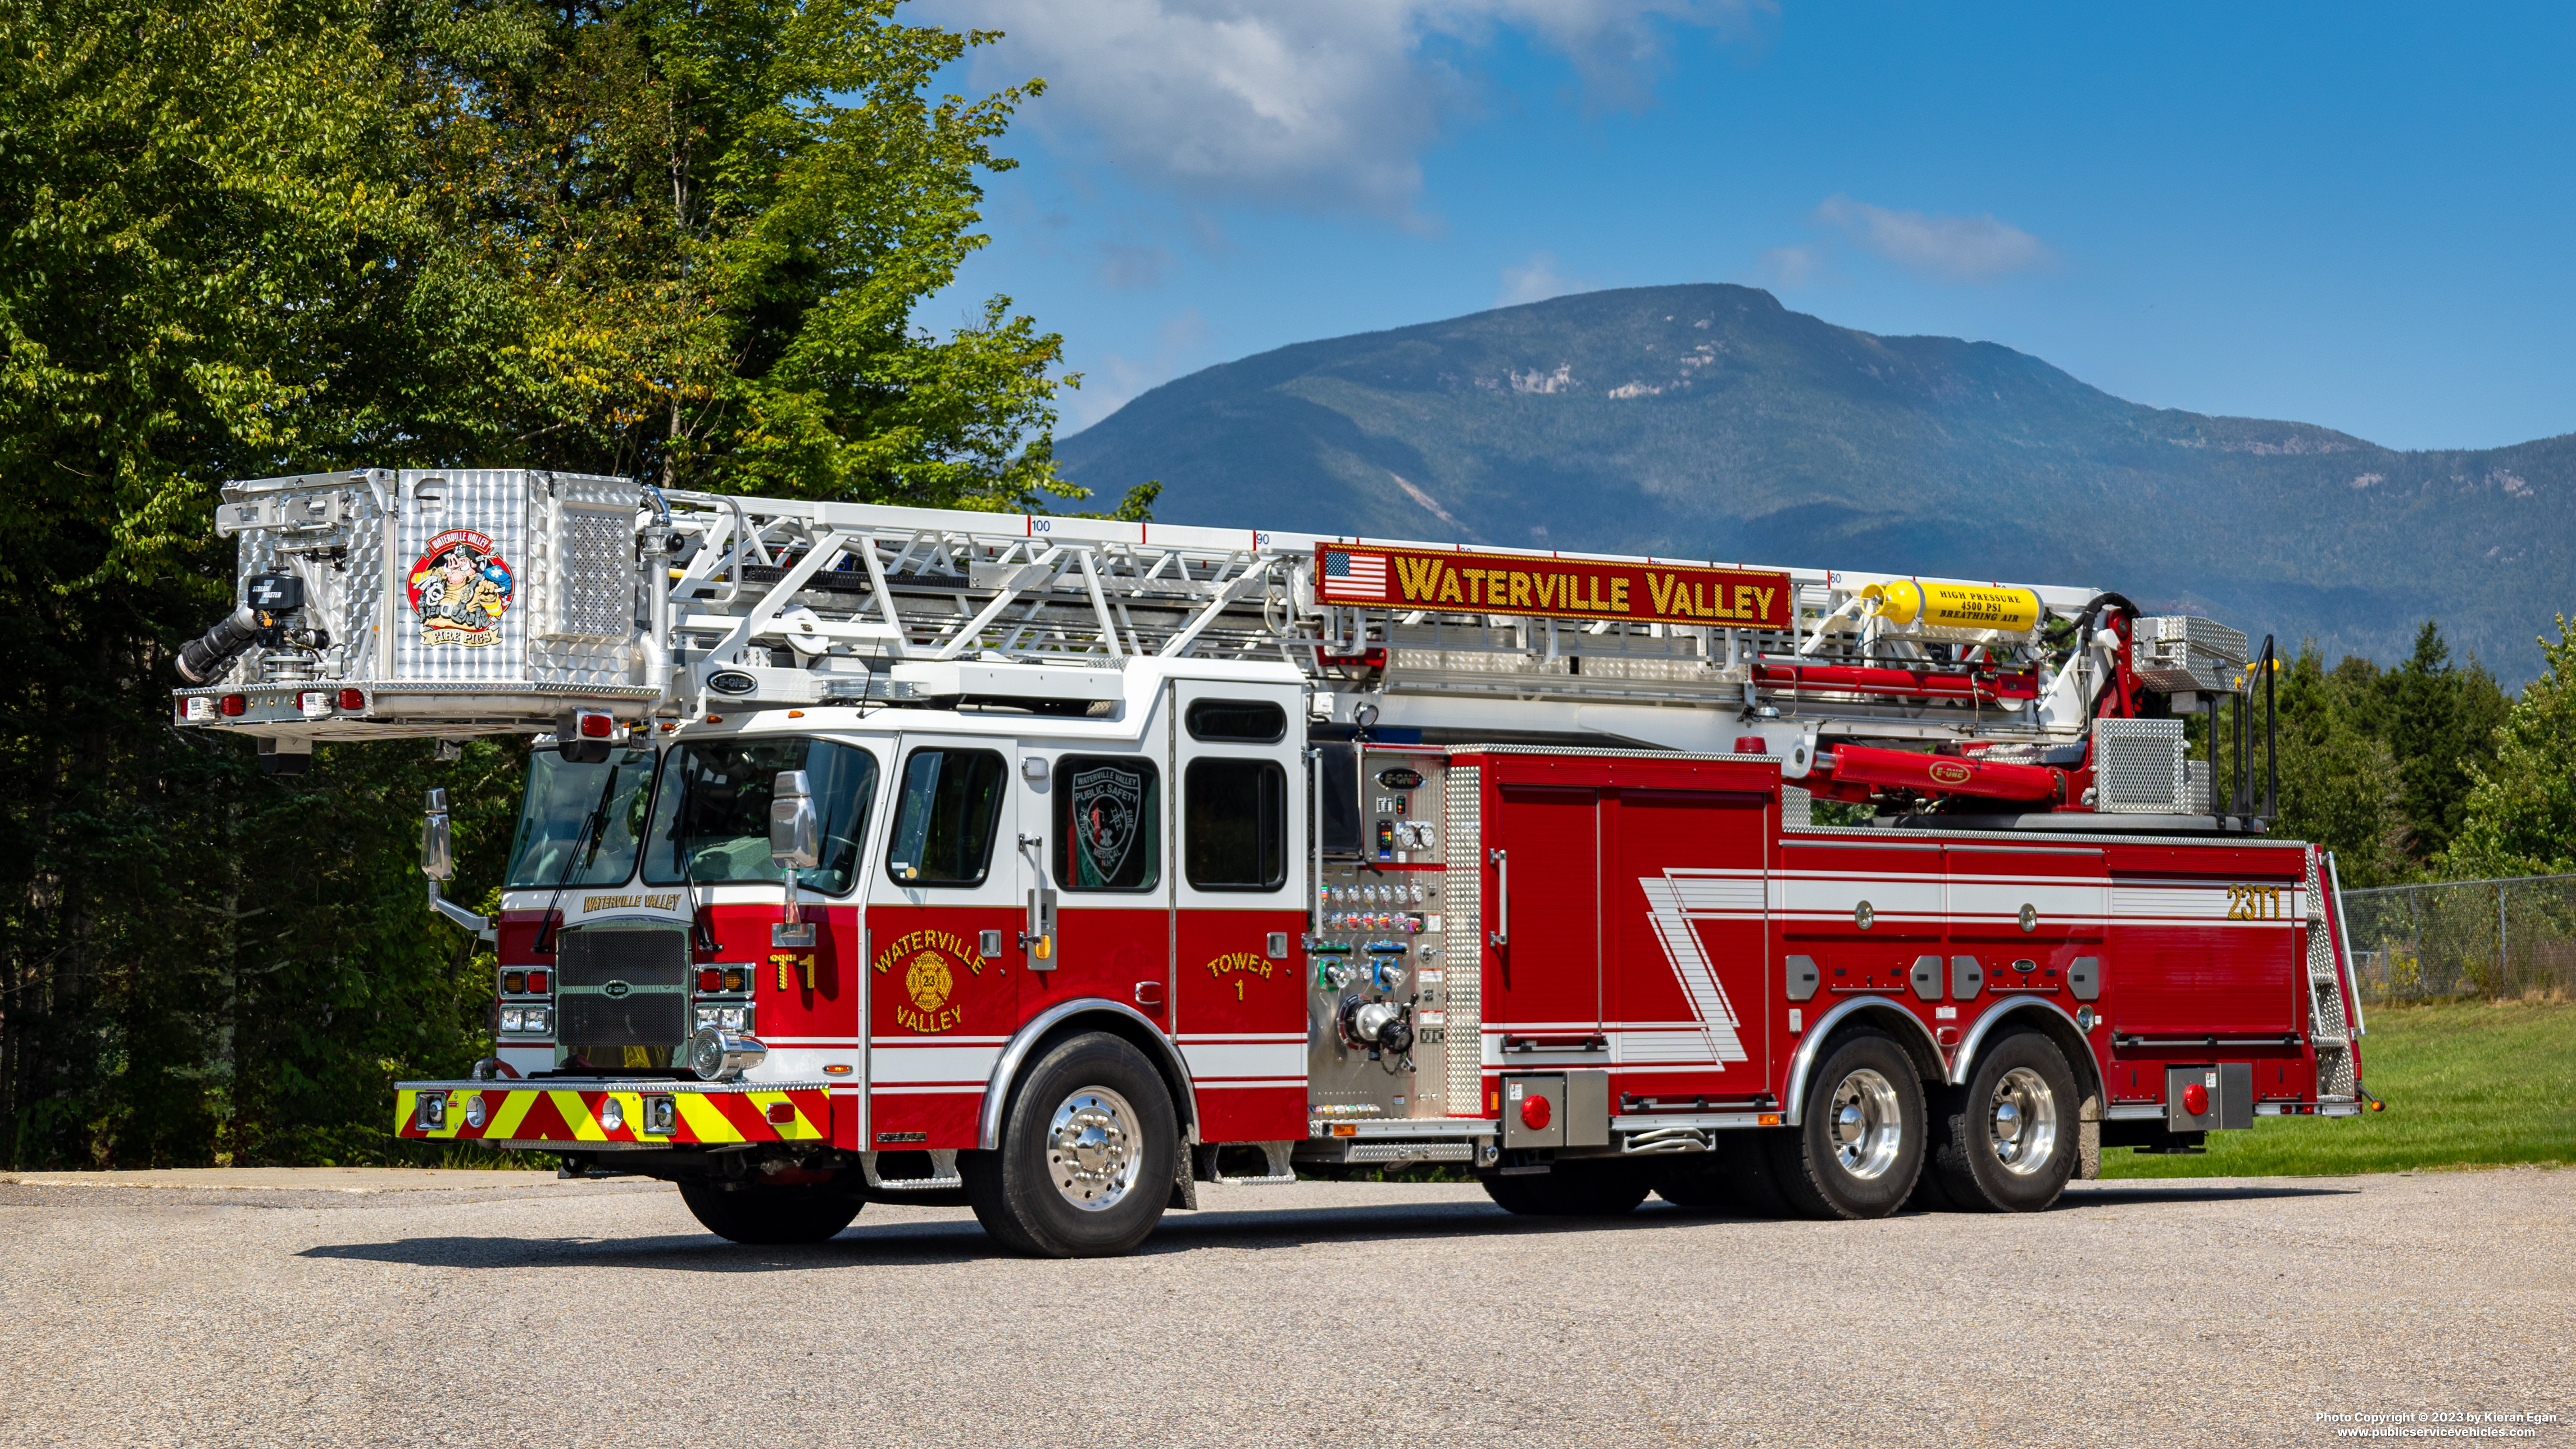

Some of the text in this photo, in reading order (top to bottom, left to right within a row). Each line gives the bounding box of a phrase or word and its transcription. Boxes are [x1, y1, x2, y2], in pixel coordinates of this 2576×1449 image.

[1032, 520, 1050, 532] 100
[467, 533, 489, 548] VALLEY
[1256, 534, 1269, 545] 90
[455, 545, 463, 553] 23
[1830, 573, 1841, 583] 60
[1393, 556, 1775, 622] WATERVILLE VALLEY
[1939, 590, 2021, 603] HIGH PRESSURE
[1961, 601, 2001, 612] 4500 PSI
[1939, 610, 2019, 623] BREATHING AIR
[432, 630, 491, 644] FIRE PIGS
[1077, 771, 1137, 785] WATERVILLE VALLEY
[1936, 767, 1964, 779] E-ONE
[1075, 784, 1138, 803] PUBLIC SAFETY
[1079, 806, 1088, 838] POLICE
[1092, 848, 1121, 859] MEDICAL
[583, 894, 682, 913] WATERVILLE VALLEY
[2227, 883, 2279, 921] 23T1
[873, 929, 987, 977] WATERVILLE
[767, 954, 815, 992] T1
[1206, 952, 1273, 981] TOWER
[923, 976, 935, 987] 23
[1234, 979, 1243, 1002] 1
[897, 1003, 961, 1033] VALLEY
